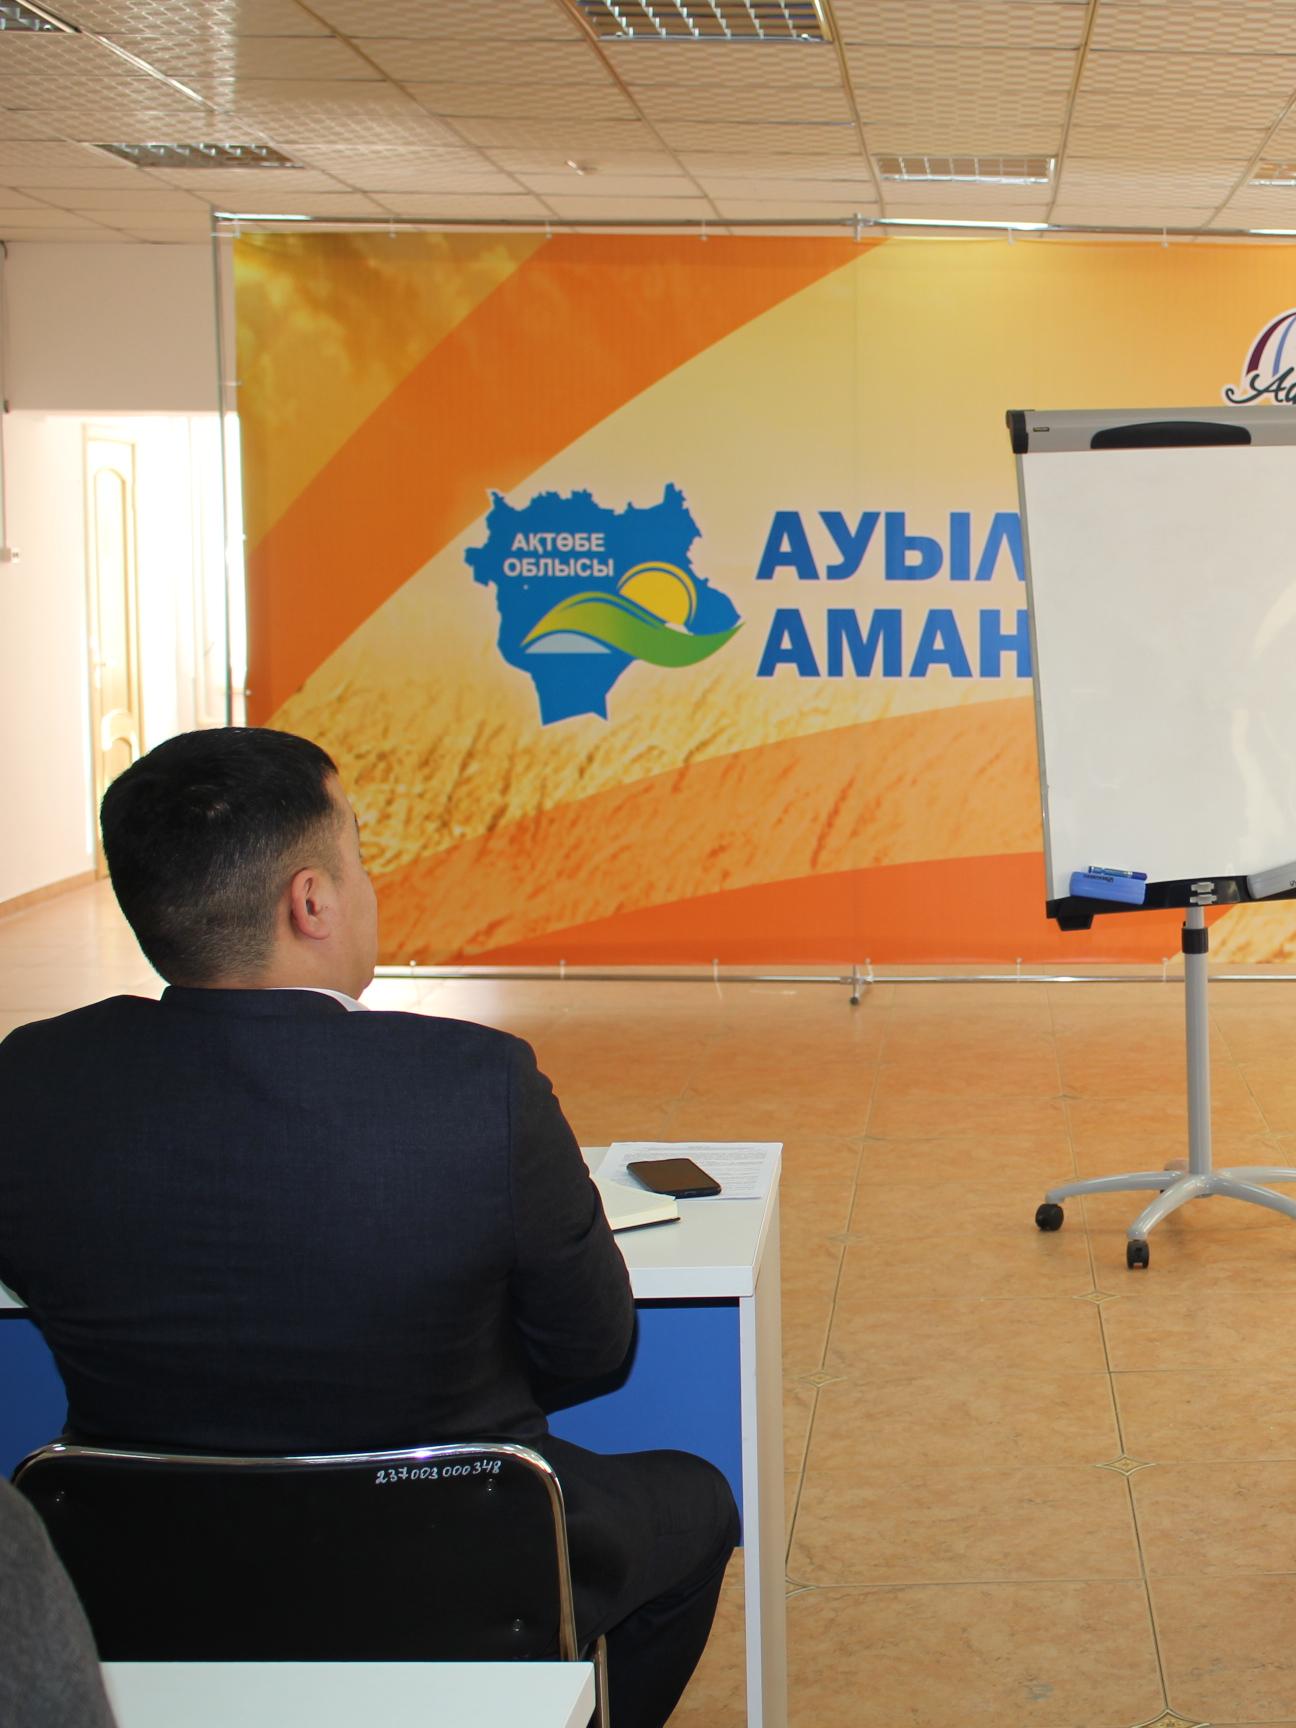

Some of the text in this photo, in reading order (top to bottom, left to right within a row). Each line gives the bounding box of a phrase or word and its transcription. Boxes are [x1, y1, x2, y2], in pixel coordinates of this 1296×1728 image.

[511, 532, 606, 554] АҚТӨБЕ
[755, 511, 1026, 581] АУЫЛ
[503, 557, 614, 577] ОБЛЫСЫ
[756, 608, 1033, 678] АМАН
